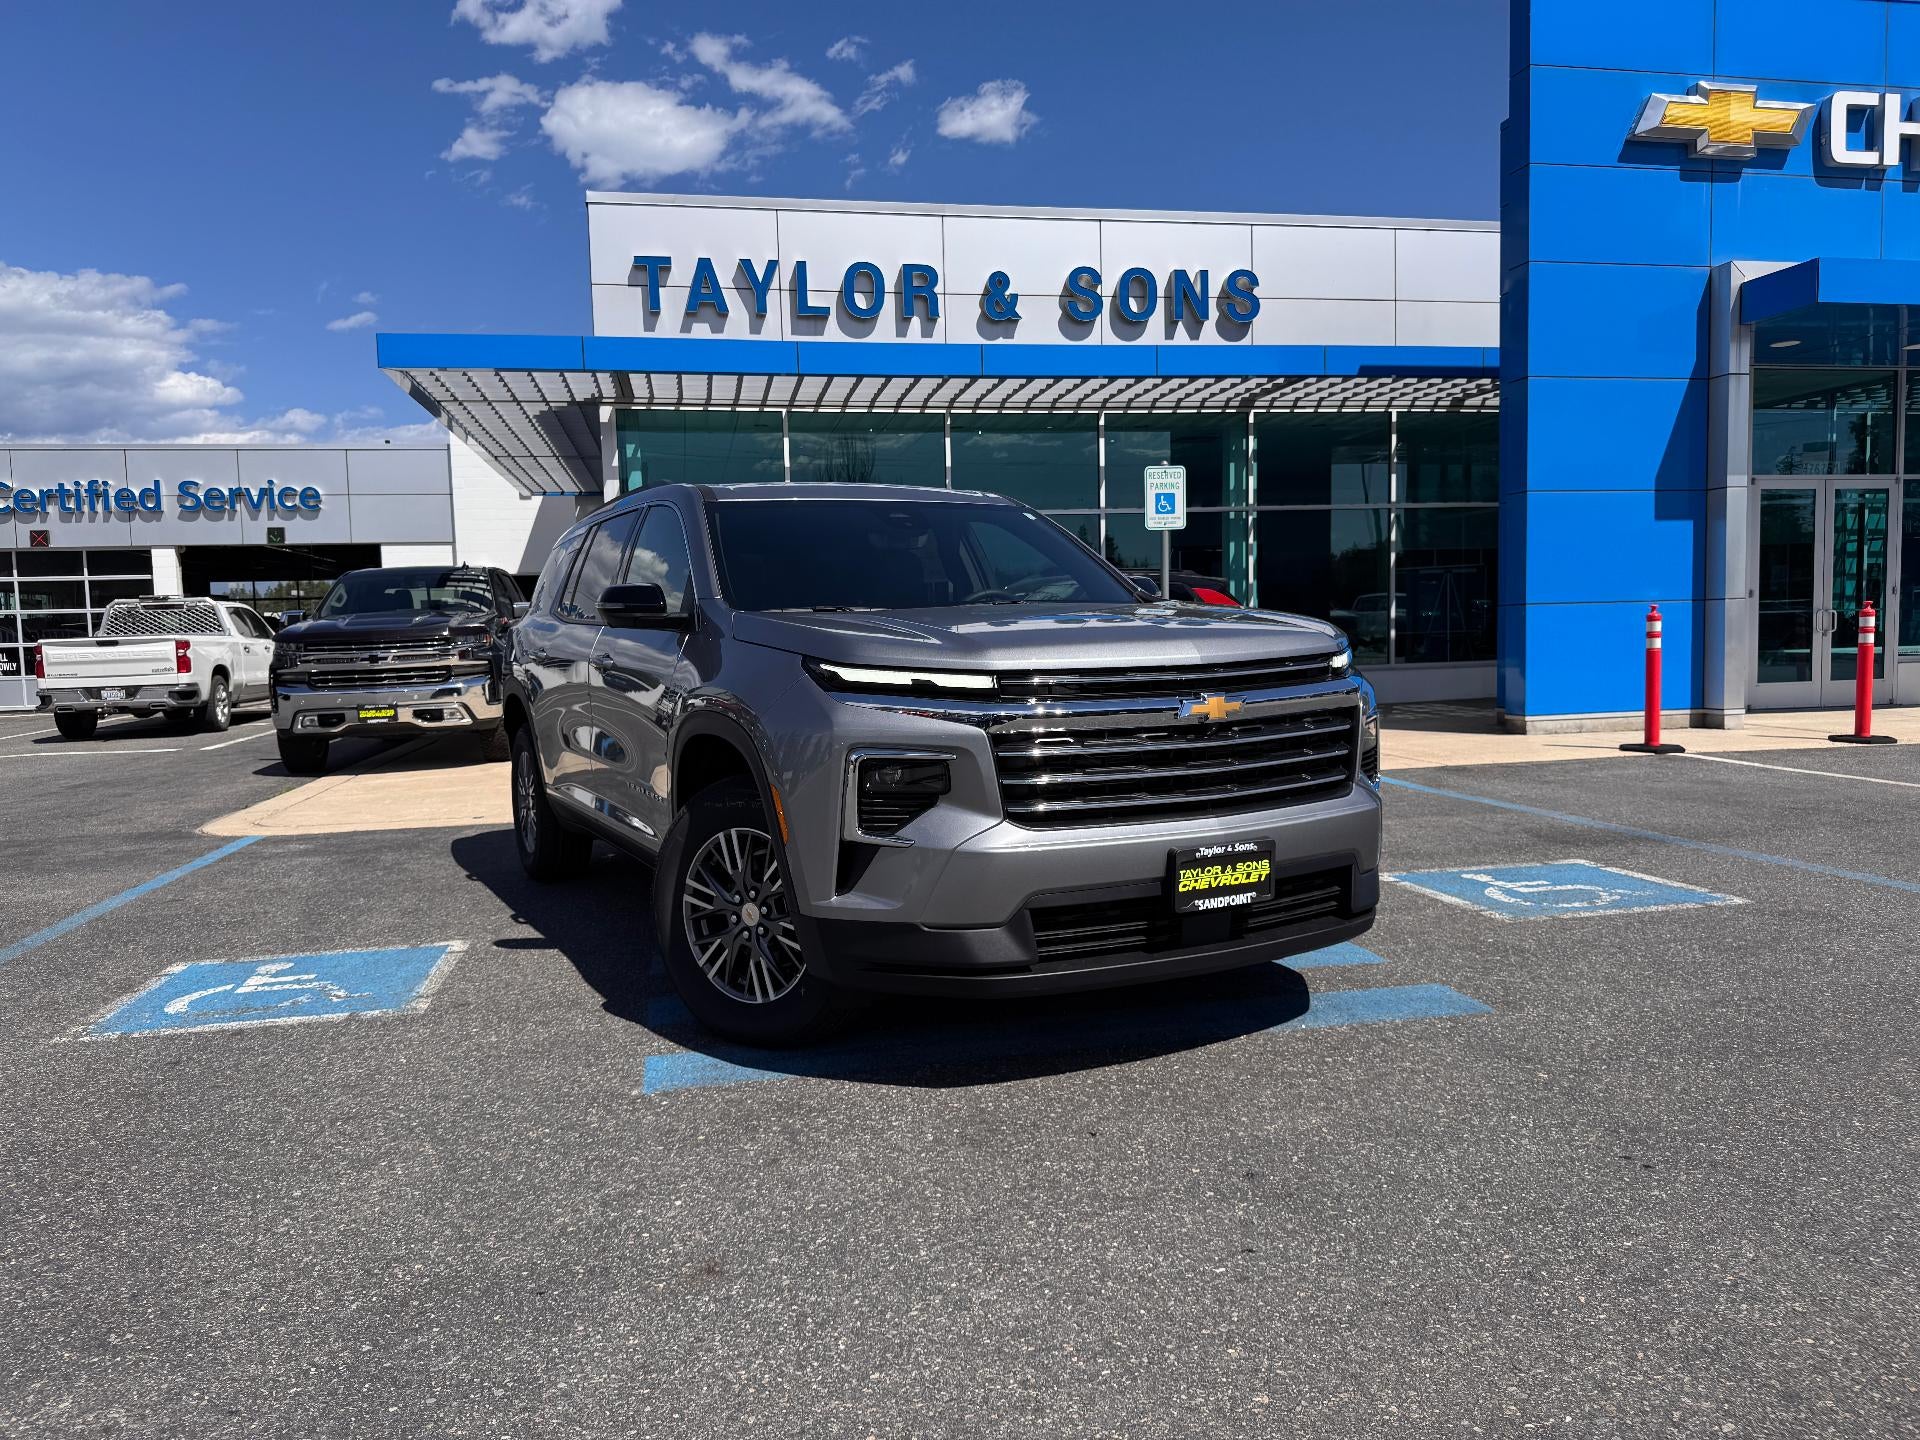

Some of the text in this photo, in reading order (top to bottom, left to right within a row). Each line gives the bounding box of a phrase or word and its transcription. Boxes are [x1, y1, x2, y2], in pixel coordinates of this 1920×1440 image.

[1830, 91, 1920, 166] CH
[633, 255, 1261, 323] TAYLOR & SONS
[1148, 471, 1182, 480] RESERVED
[177, 480, 322, 512] Service
[1150, 482, 1180, 491] PARKING
[1199, 842, 1255, 858] Taylor & Sons
[1180, 859, 1270, 880] TAYLOR & SONS
[1178, 870, 1270, 892] CHEVROLET
[1198, 893, 1252, 911] SANDPOINT
